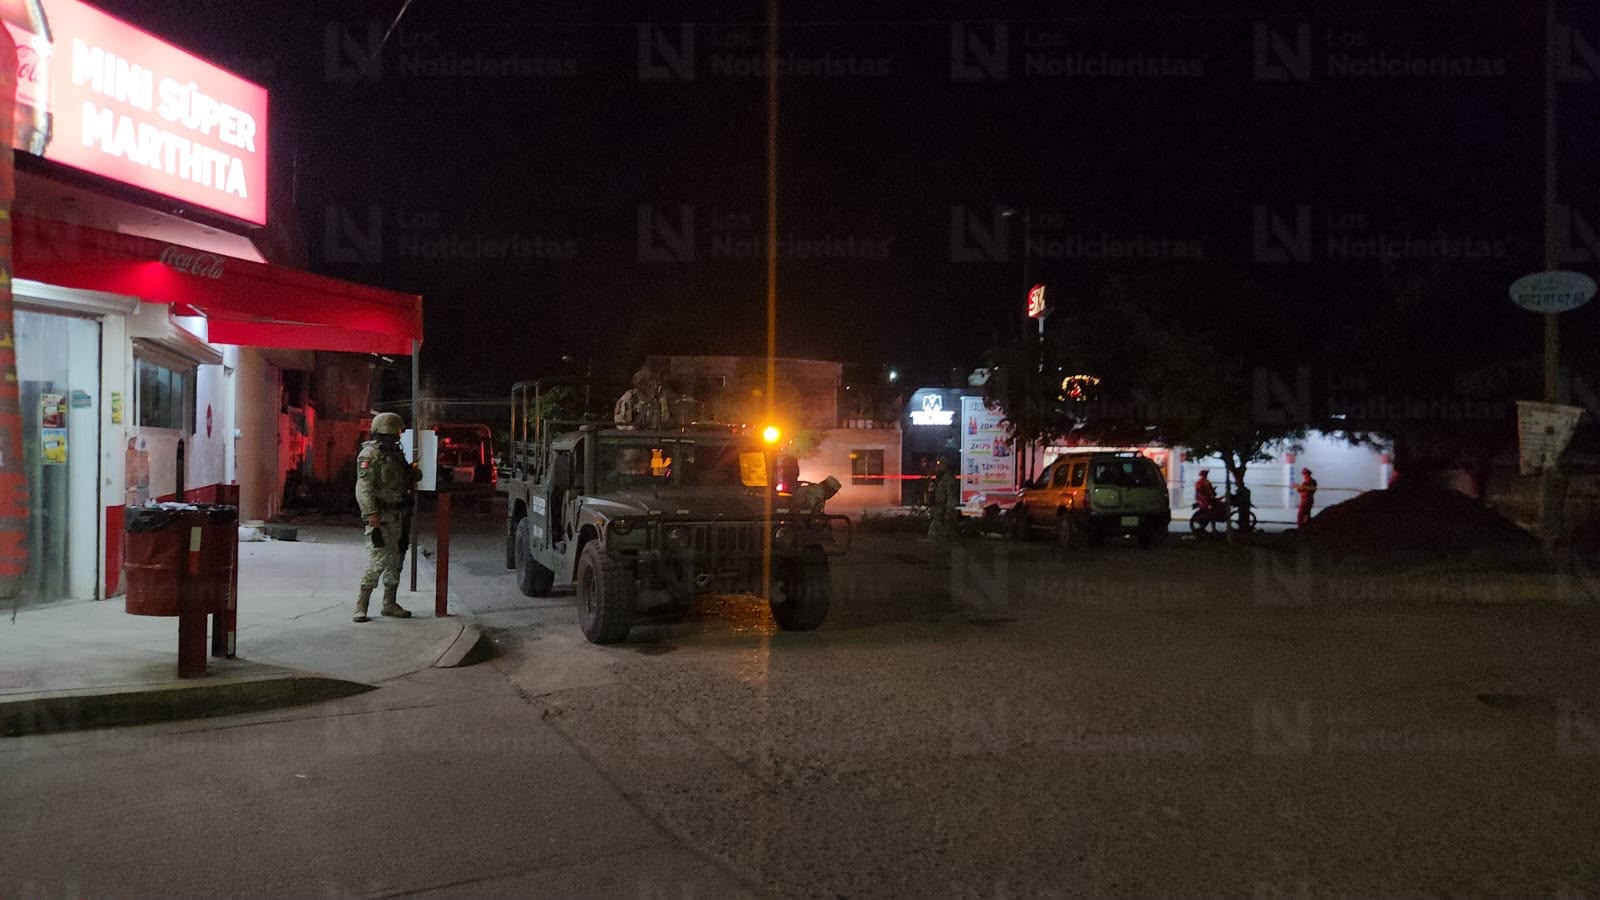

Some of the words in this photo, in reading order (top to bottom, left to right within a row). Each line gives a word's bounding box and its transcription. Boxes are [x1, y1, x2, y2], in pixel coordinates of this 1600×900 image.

[72, 38, 153, 113] MINI
[158, 77, 256, 153] SÚPER
[82, 101, 248, 198] MARTHITA
